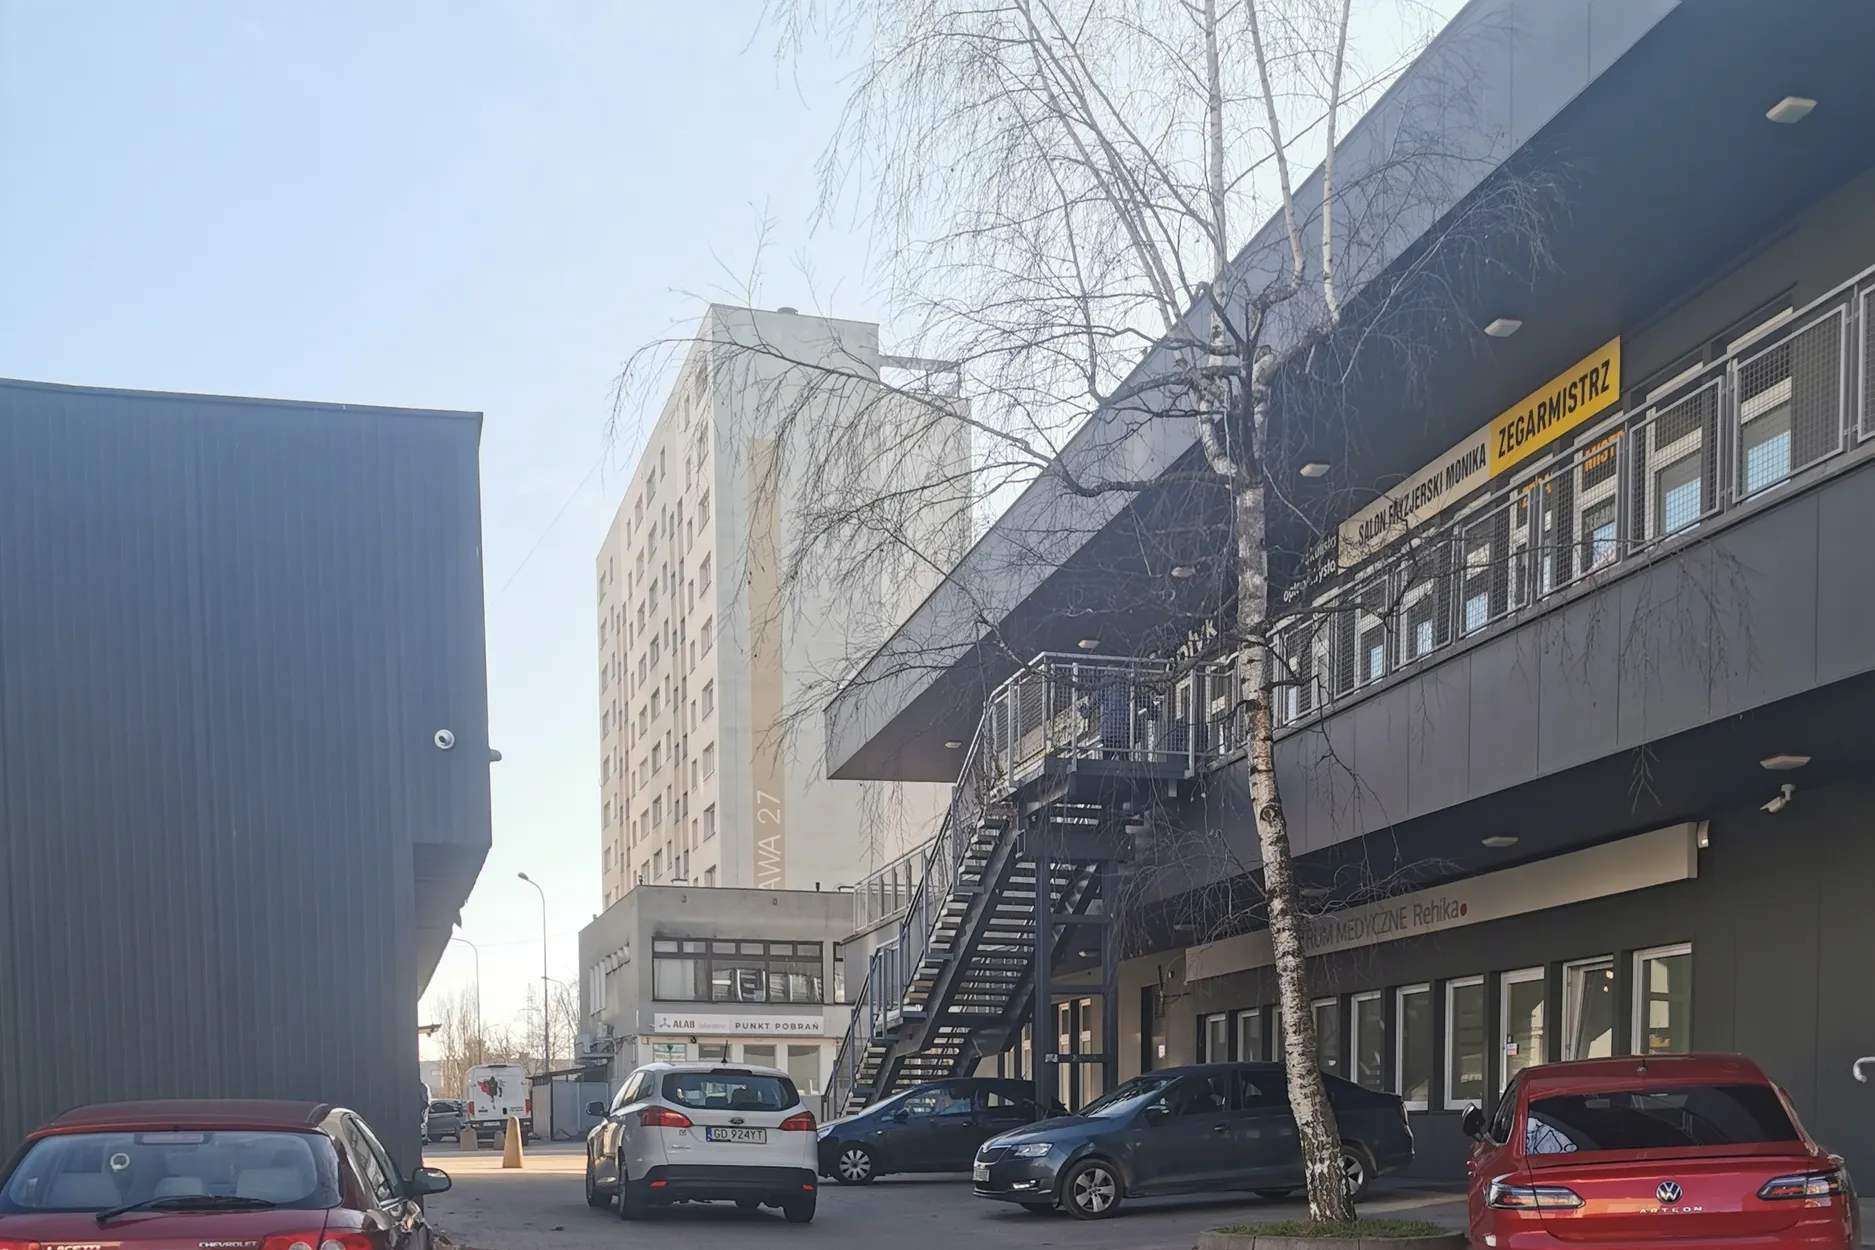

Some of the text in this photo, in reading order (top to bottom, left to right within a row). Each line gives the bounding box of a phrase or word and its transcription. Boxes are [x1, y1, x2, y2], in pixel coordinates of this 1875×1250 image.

[1498, 359, 1610, 459] ZEGARMISTRZ
[1358, 510, 1387, 546] SALON
[1446, 442, 1486, 491] MONIKA
[757, 790, 780, 825] 27
[1301, 897, 1459, 951] TRUM MEDYCZNE Rehika
[673, 1020, 695, 1029] ALAB
[735, 1022, 770, 1030] PUNKT
[775, 1021, 819, 1030] POBRAŃ
[713, 1128, 763, 1140] GD 924YT
[1639, 1206, 1703, 1214] ARTEON
